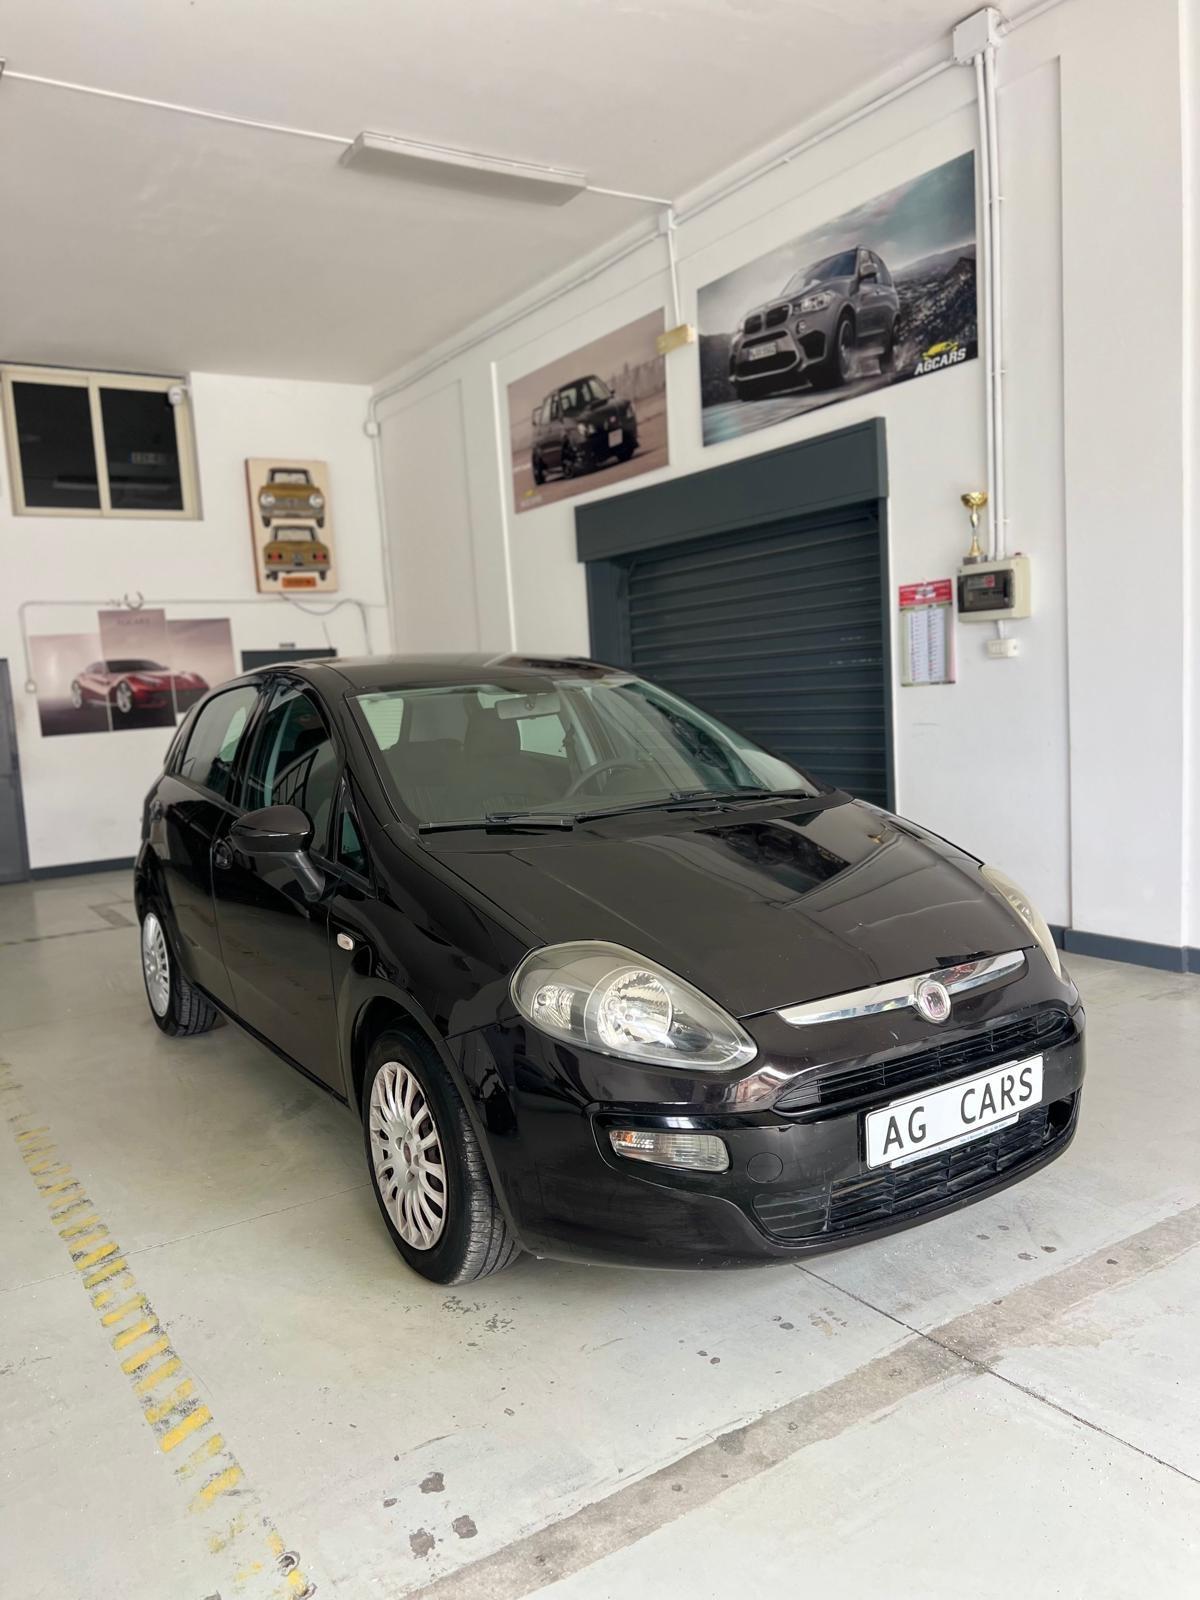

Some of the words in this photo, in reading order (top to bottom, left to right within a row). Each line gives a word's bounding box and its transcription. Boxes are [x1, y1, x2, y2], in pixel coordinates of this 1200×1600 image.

[914, 348, 967, 376] AGCARS
[883, 1106, 927, 1155] AG
[960, 1067, 1033, 1124] CARS
